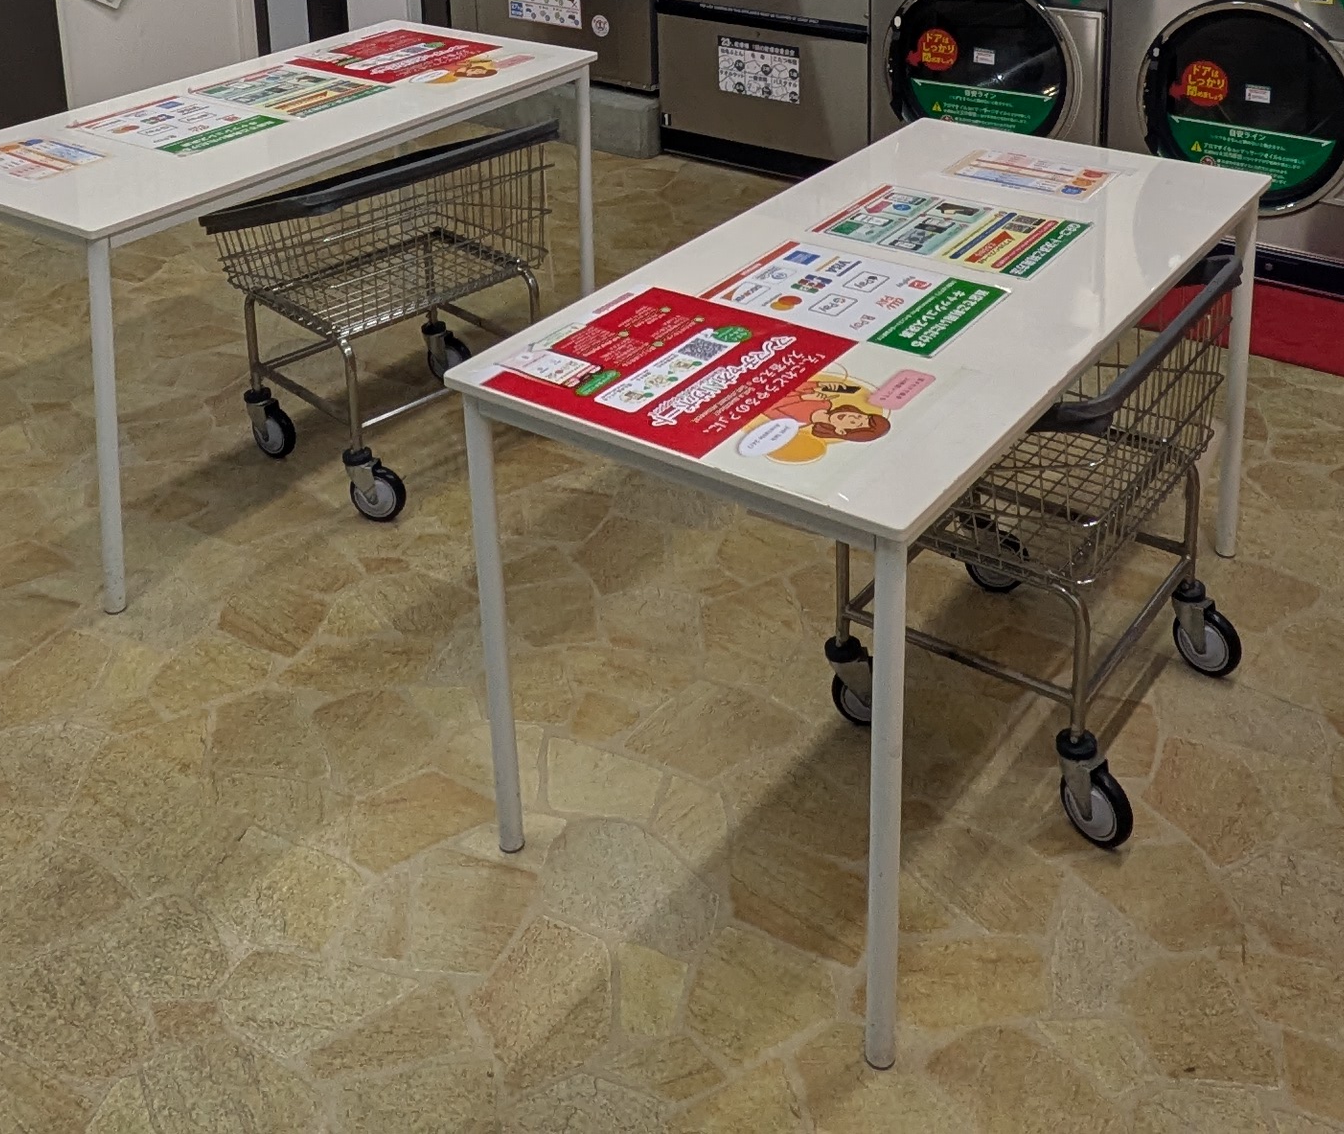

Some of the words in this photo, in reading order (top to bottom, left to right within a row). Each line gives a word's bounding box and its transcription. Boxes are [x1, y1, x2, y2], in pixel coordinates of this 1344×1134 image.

[926, 33, 949, 43] ドアは
[922, 43, 955, 54] しっかり
[1192, 66, 1219, 77] ドアは
[1188, 75, 1224, 89] しっかり
[1229, 129, 1267, 141] 目安ライン
[826, 260, 850, 273] VISA
